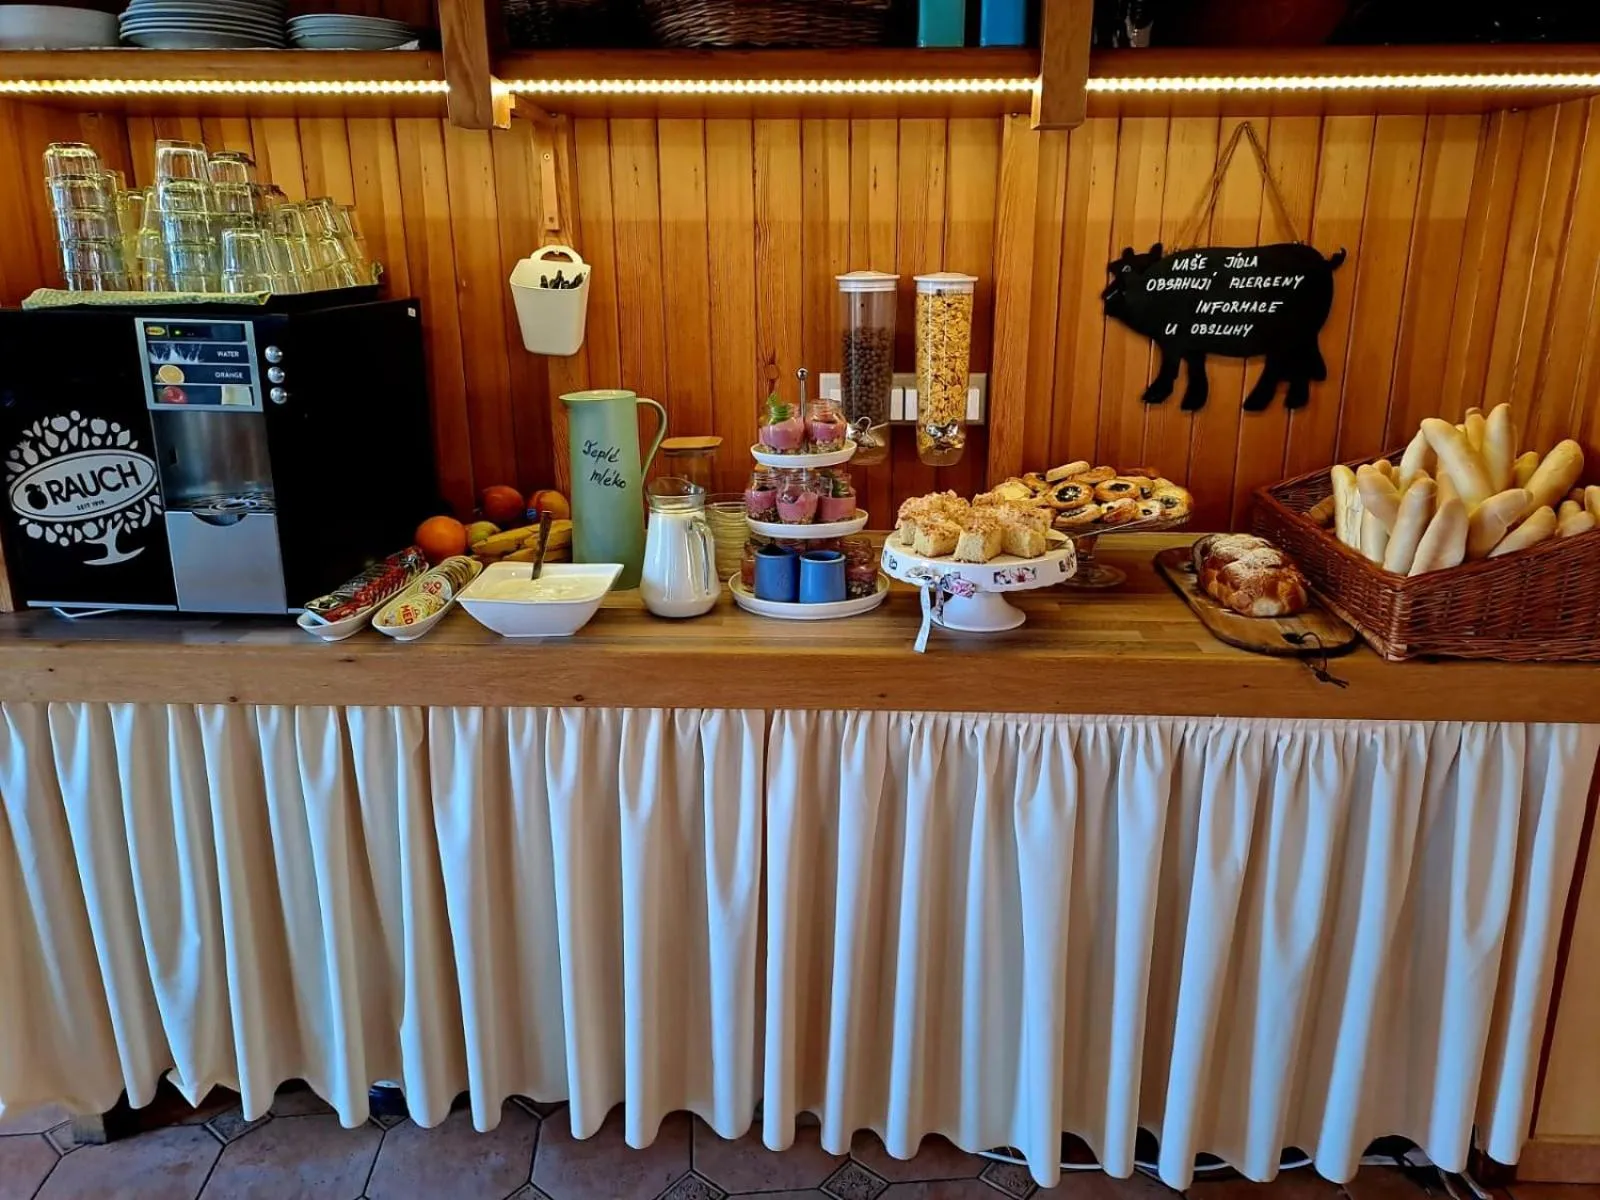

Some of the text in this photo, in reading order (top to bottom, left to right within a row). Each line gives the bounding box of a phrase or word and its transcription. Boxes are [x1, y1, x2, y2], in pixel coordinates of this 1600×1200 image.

[1172, 252, 1259, 271] NAŠE JÍDLA
[1146, 271, 1304, 291] OBSAHUJÍ ALERGENY
[1195, 300, 1283, 315] INFORMACE
[1191, 324, 1254, 337] OBSLUHY
[45, 461, 142, 505] RAUCH
